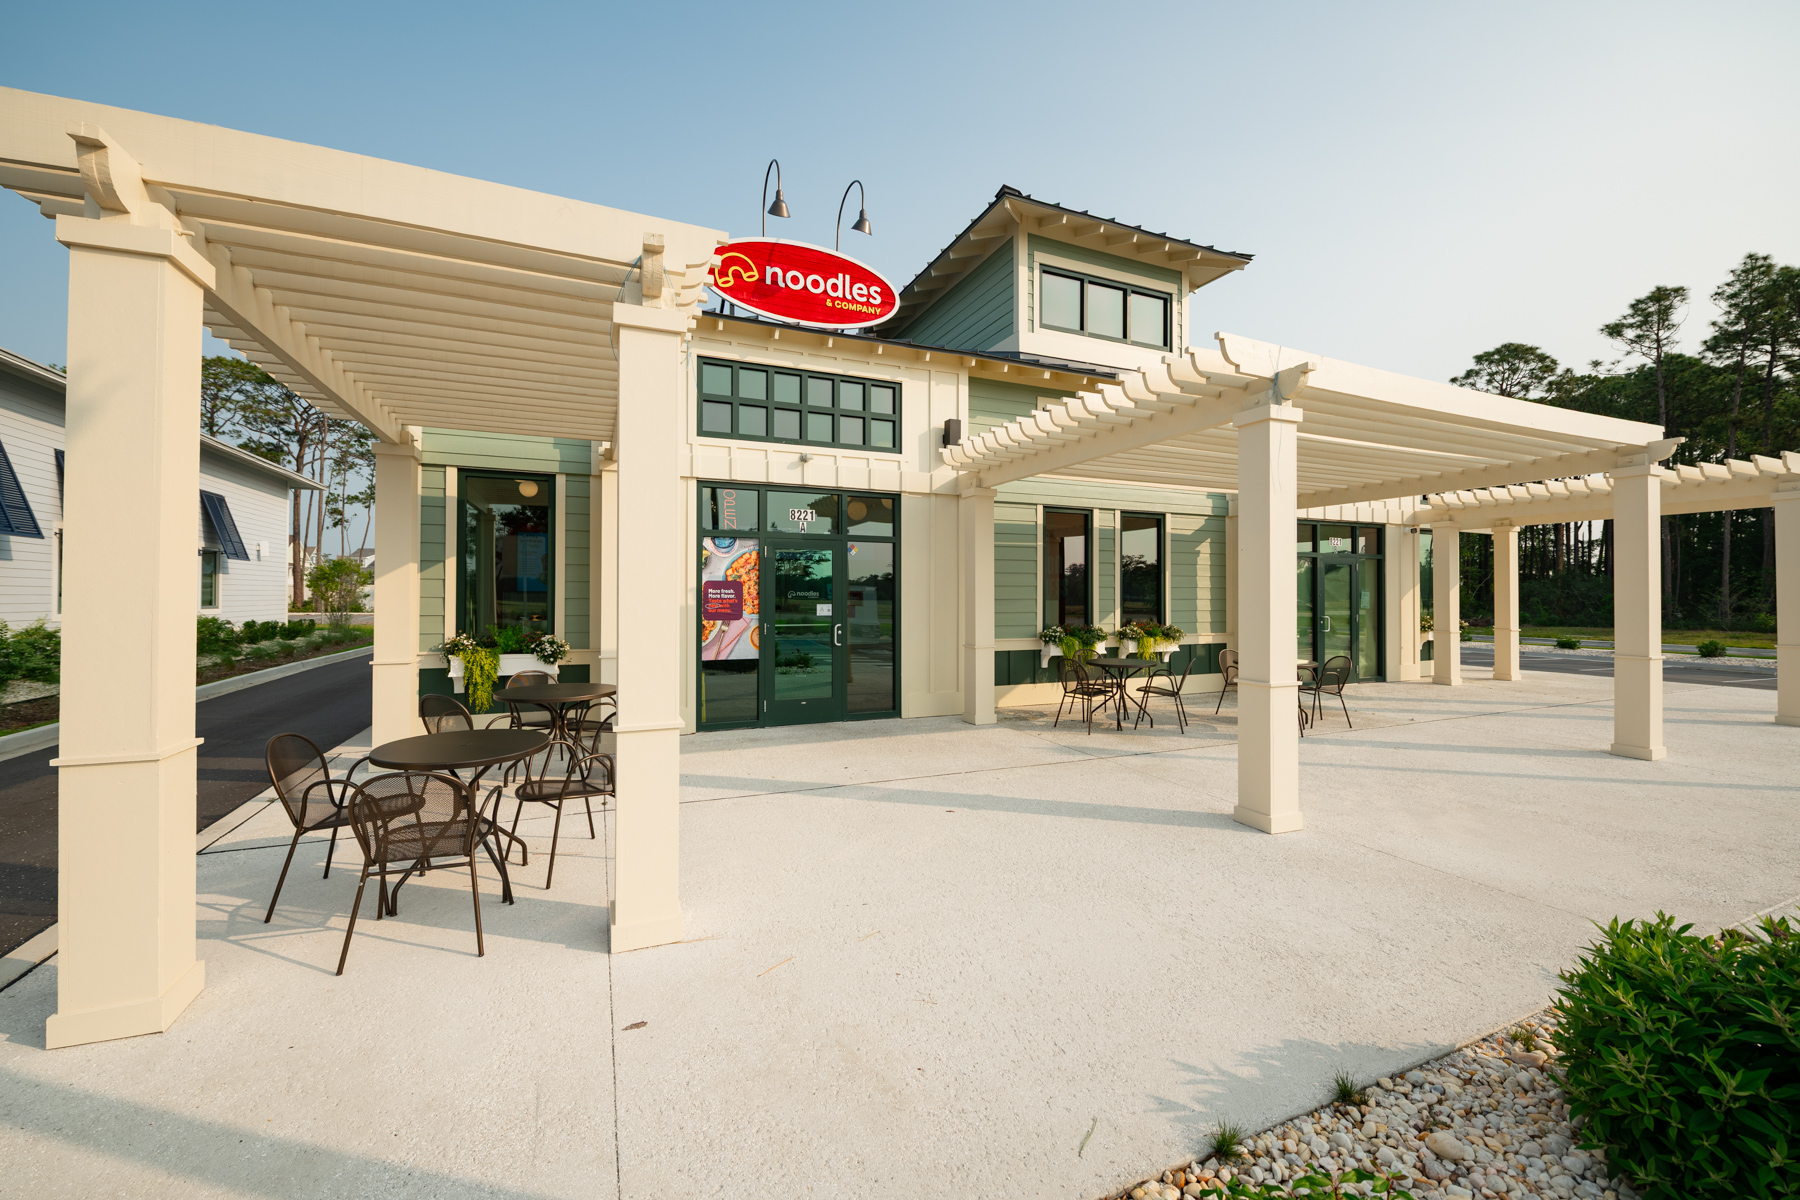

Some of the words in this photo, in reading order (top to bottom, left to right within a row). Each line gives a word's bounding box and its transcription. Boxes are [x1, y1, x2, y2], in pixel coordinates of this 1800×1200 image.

[766, 266, 882, 305] noodles
[826, 299, 832, 307] &
[834, 300, 882, 315] COMPANY
[723, 489, 737, 530] OPEN
[790, 509, 814, 521] 8221
[799, 522, 806, 533] A
